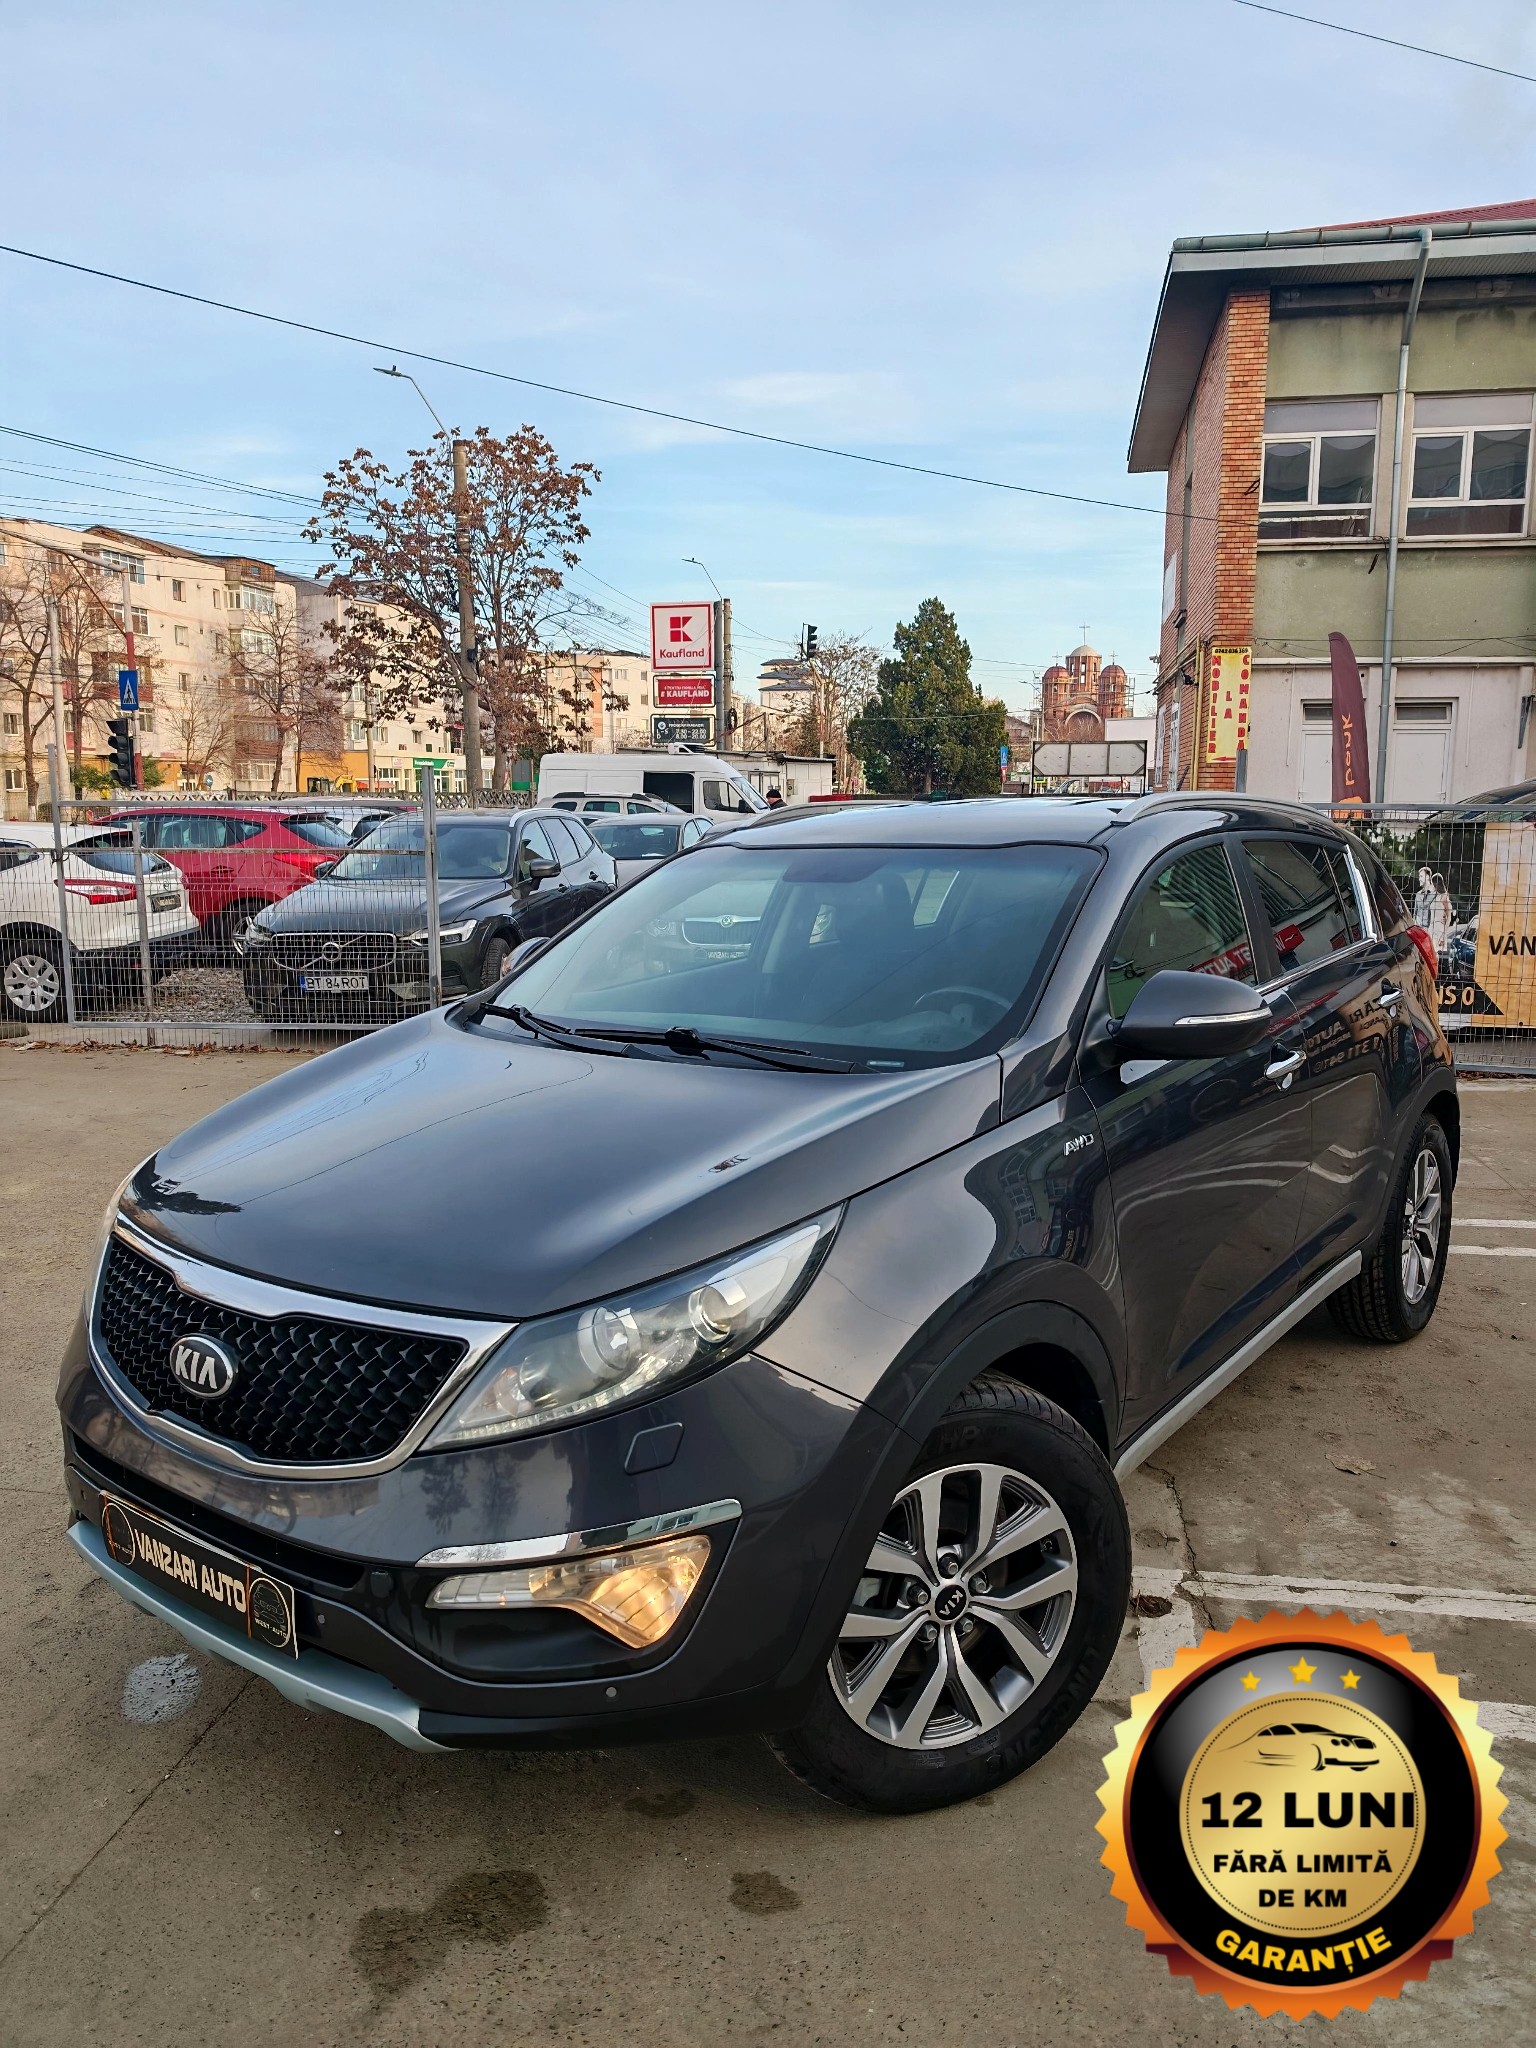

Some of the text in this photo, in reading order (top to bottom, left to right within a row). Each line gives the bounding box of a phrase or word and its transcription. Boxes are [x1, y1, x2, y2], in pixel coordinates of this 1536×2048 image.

[670, 616, 693, 642] K
[659, 648, 705, 658] Kaufland
[666, 690, 710, 698] KAUFLAND
[1208, 655, 1221, 753] MOBILIER
[1224, 691, 1232, 719] LA
[306, 978, 321, 988] BT
[1064, 1133, 1095, 1156] AWD
[174, 1345, 218, 1390] KIA
[134, 1528, 247, 1613] VANZARI AUTO
[939, 1590, 964, 1616] KIA
